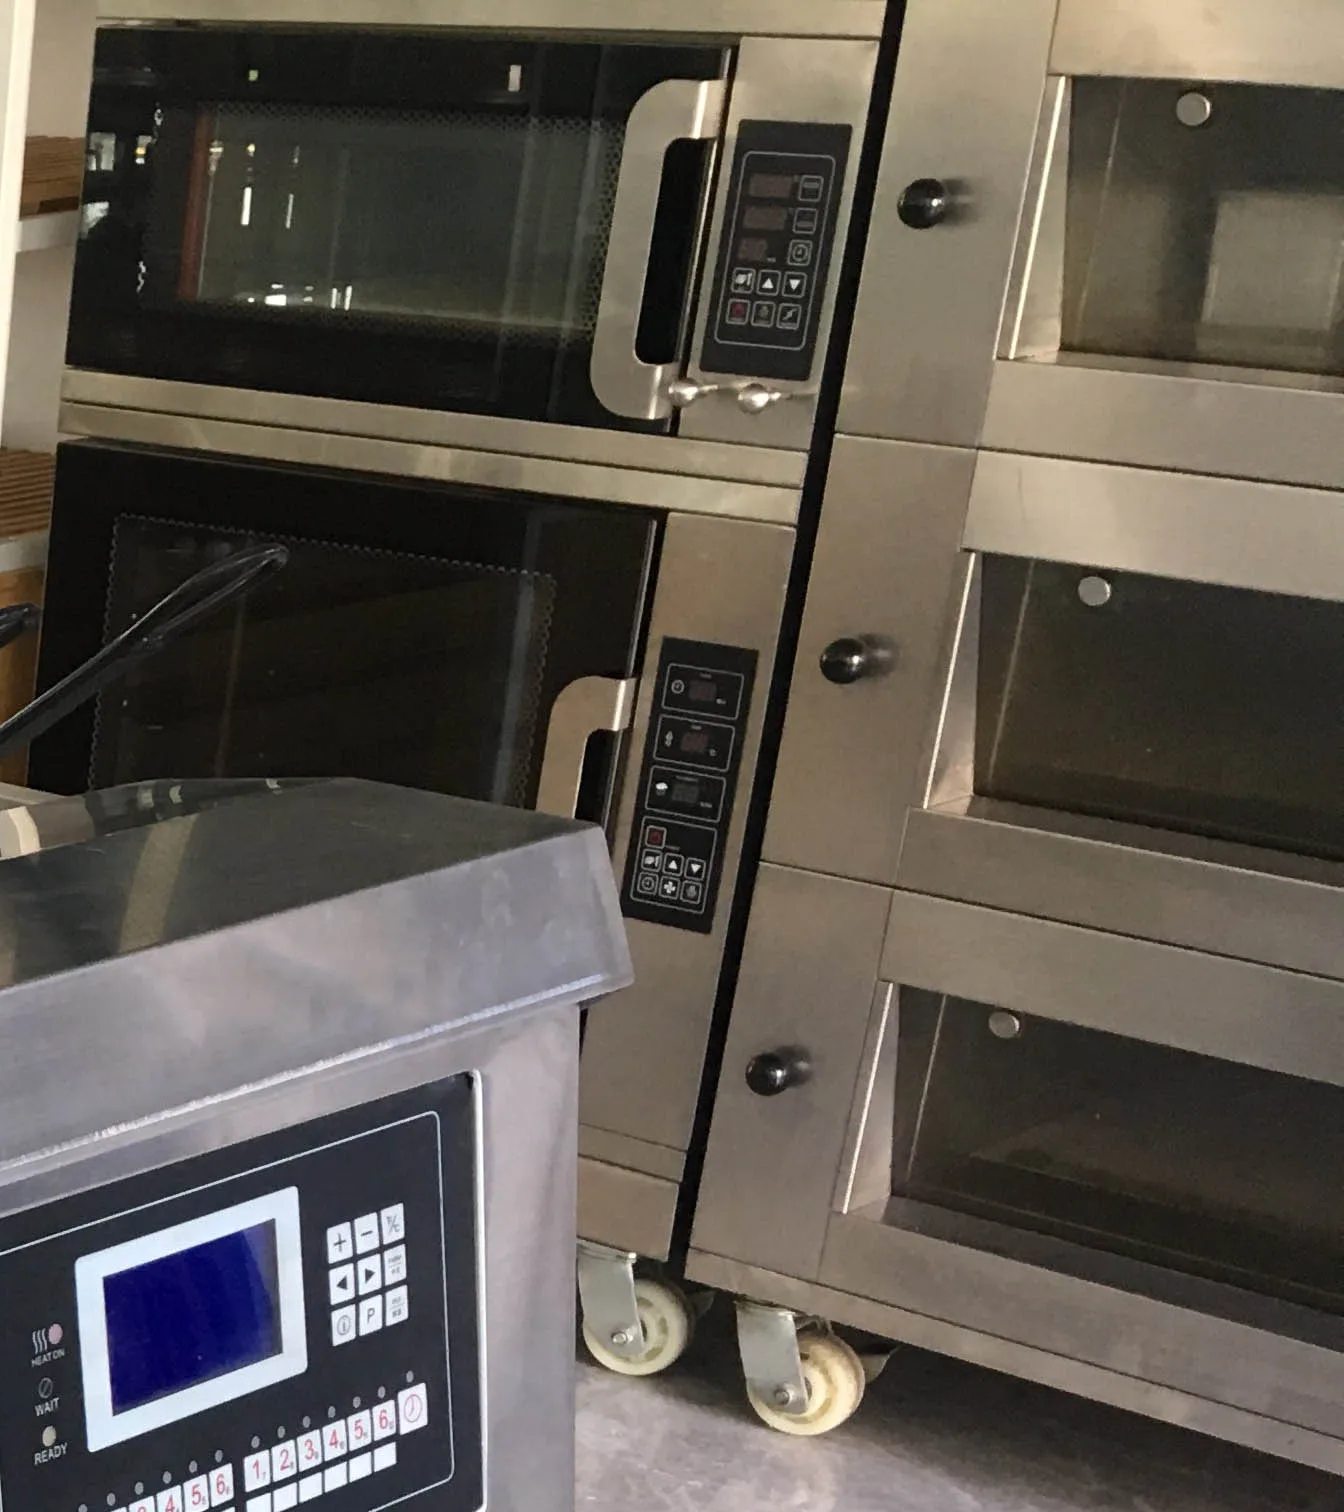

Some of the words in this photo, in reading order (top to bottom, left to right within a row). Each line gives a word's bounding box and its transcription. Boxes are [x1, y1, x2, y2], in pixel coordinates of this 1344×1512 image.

[32, 1354, 52, 1368] HEAT
[52, 1348, 66, 1360] ON
[34, 1397, 60, 1417] WAIT
[34, 1443, 68, 1466] READY
[252, 1458, 260, 1480] 1
[279, 1448, 290, 1471] 2
[304, 1438, 315, 1460] 3
[329, 1428, 340, 1450] 4
[354, 1419, 364, 1440] 5
[378, 1409, 388, 1430] 6
[191, 1484, 202, 1506] 5
[216, 1473, 226, 1496] 6
